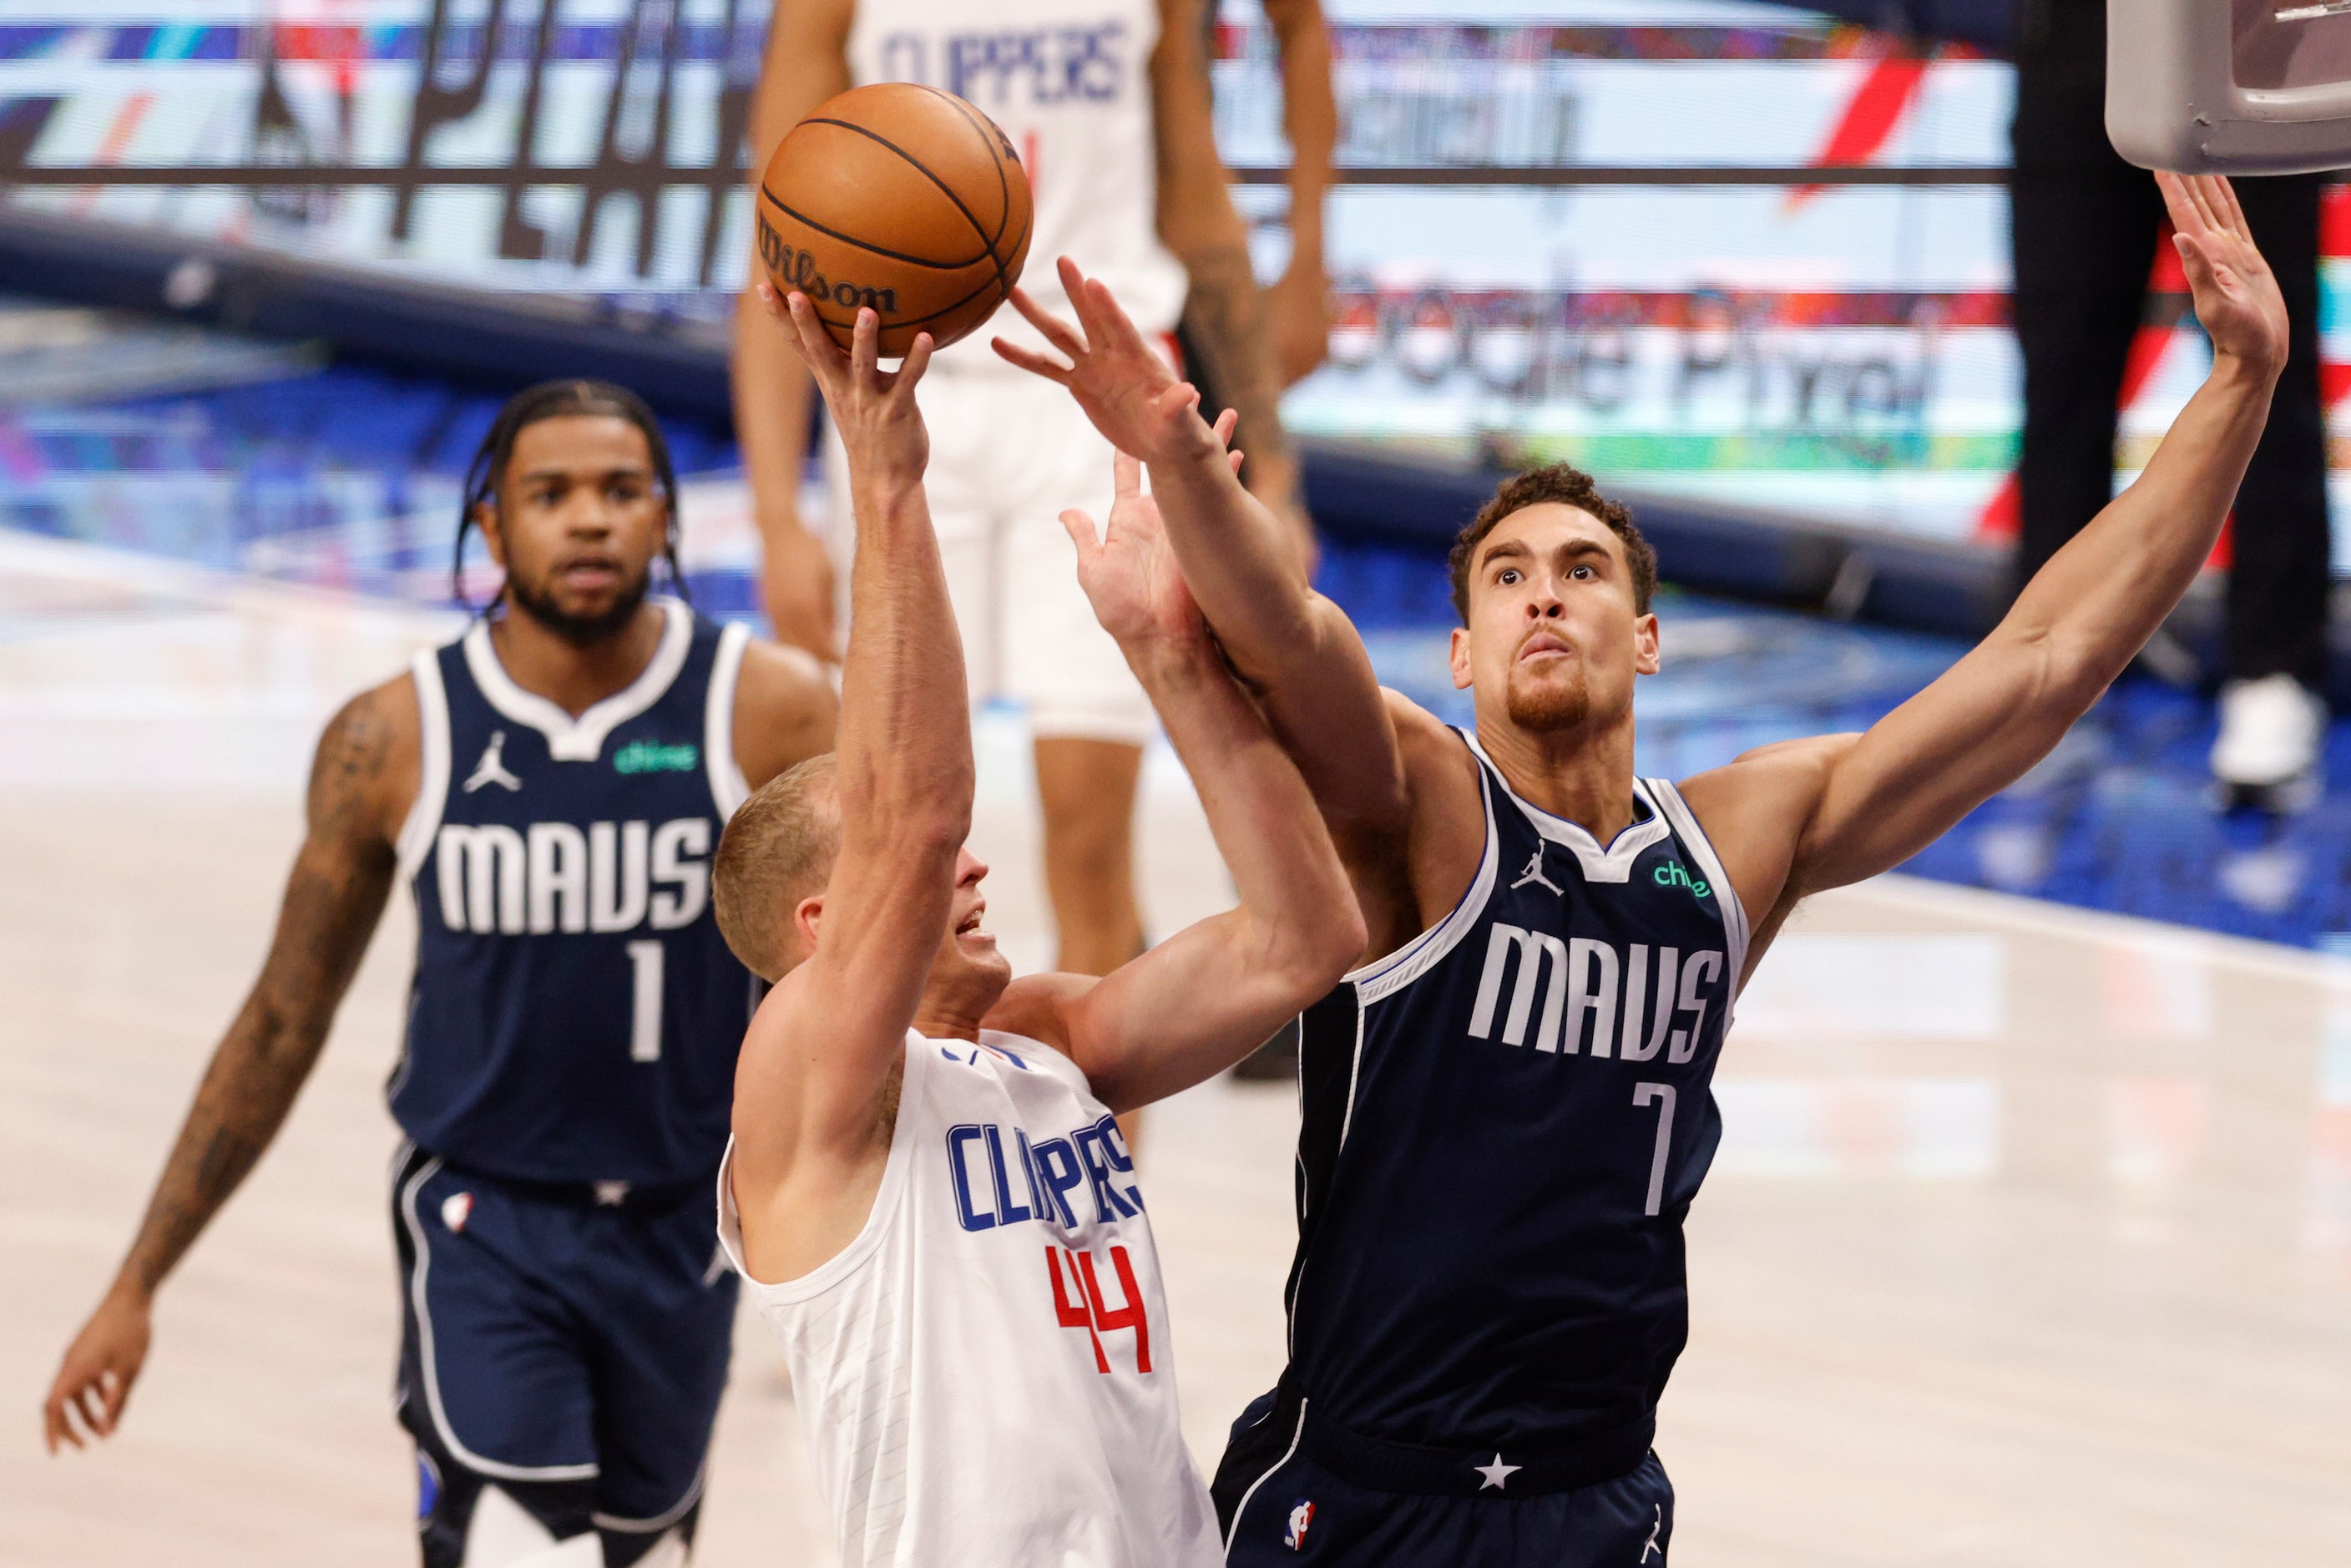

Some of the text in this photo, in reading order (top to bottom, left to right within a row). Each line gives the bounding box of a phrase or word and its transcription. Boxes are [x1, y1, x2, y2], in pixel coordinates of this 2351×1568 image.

[759, 209, 897, 312] Wilson
[436, 817, 712, 936] MAVS
[1654, 860, 1711, 898] chie
[627, 940, 665, 1062] 1
[1468, 922, 1723, 1065] MAVS
[946, 1114, 1145, 1232] CLIPES
[1632, 1081, 1677, 1216] 7
[1045, 1245, 1152, 1374] 44
